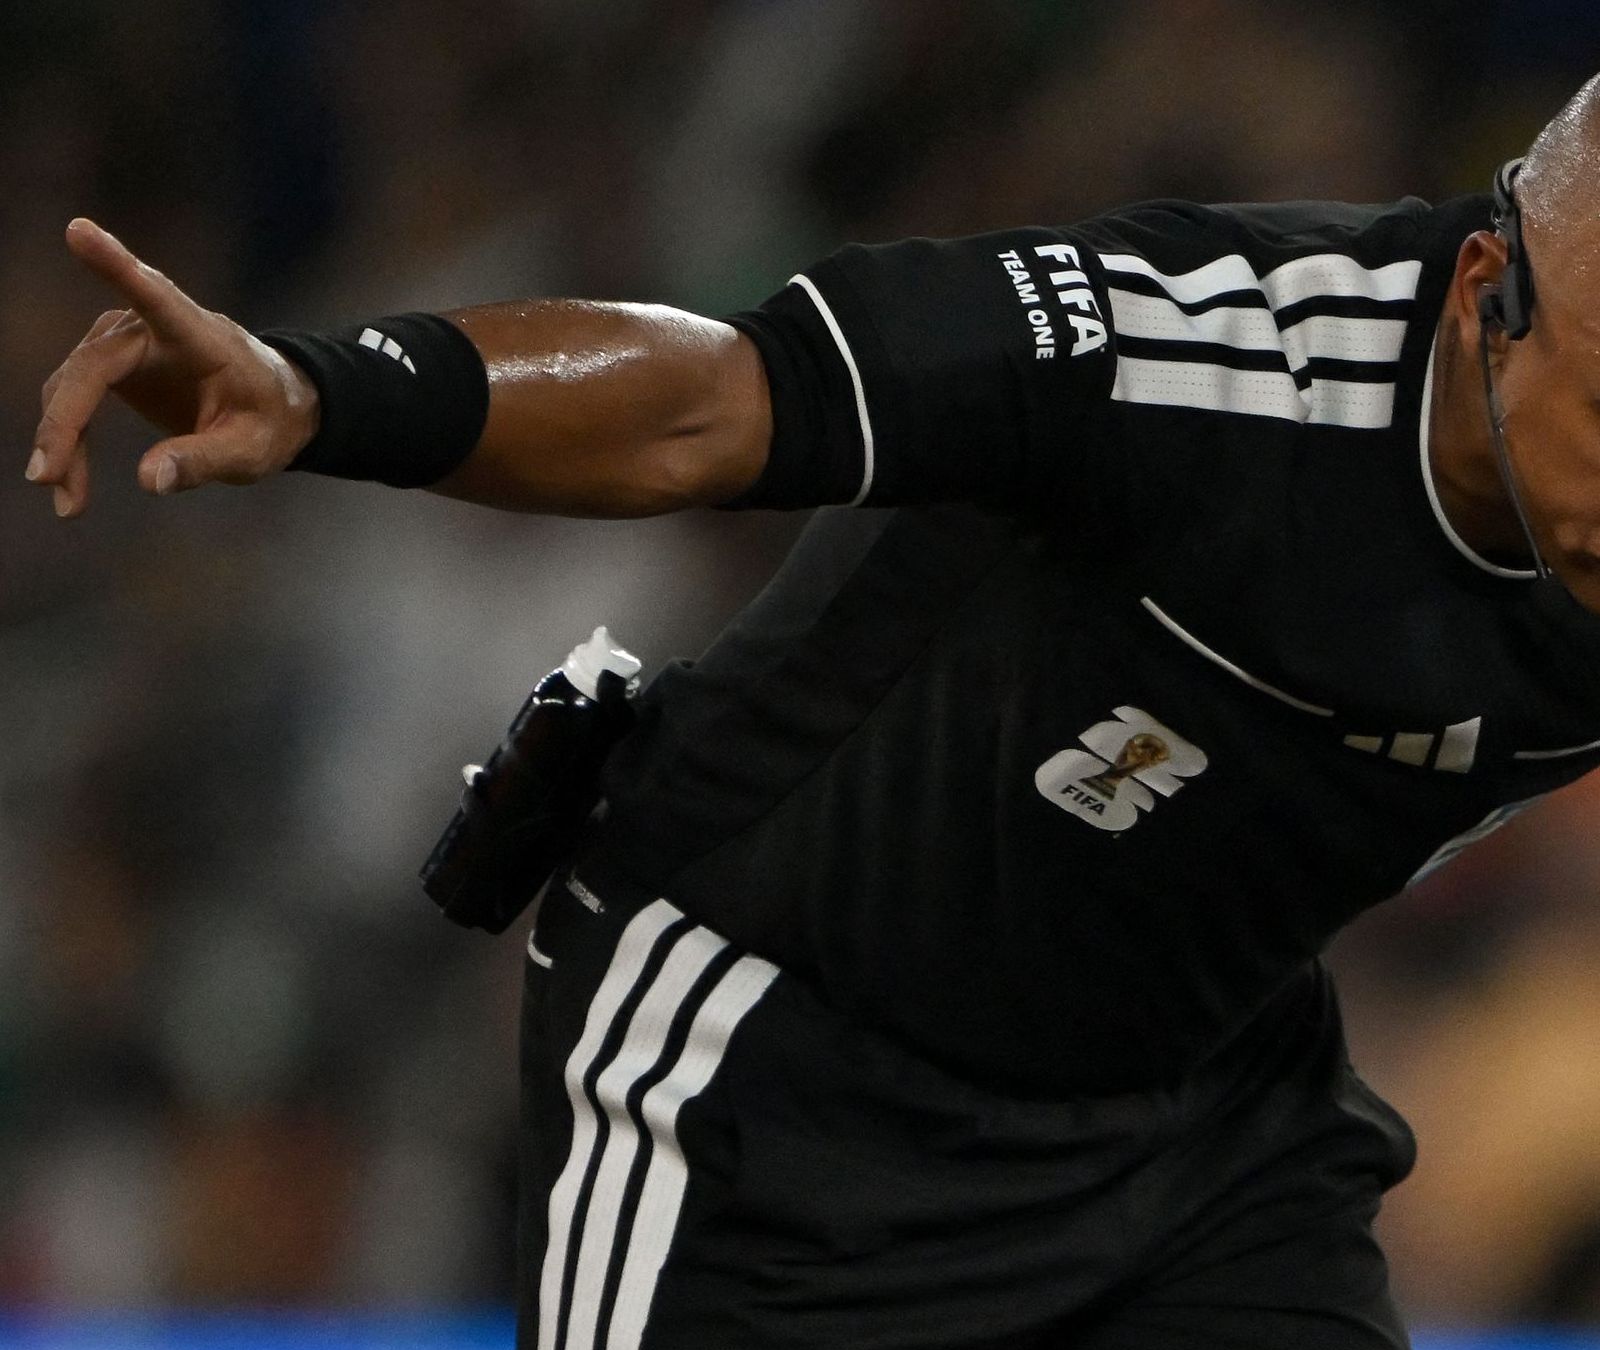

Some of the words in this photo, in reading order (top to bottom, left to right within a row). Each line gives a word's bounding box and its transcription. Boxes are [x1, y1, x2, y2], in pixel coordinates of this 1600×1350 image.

[998, 250, 1040, 304] TEAM
[1028, 309, 1055, 360] ONE
[1034, 244, 1107, 356] FIFA
[1060, 784, 1107, 815] FIFA
